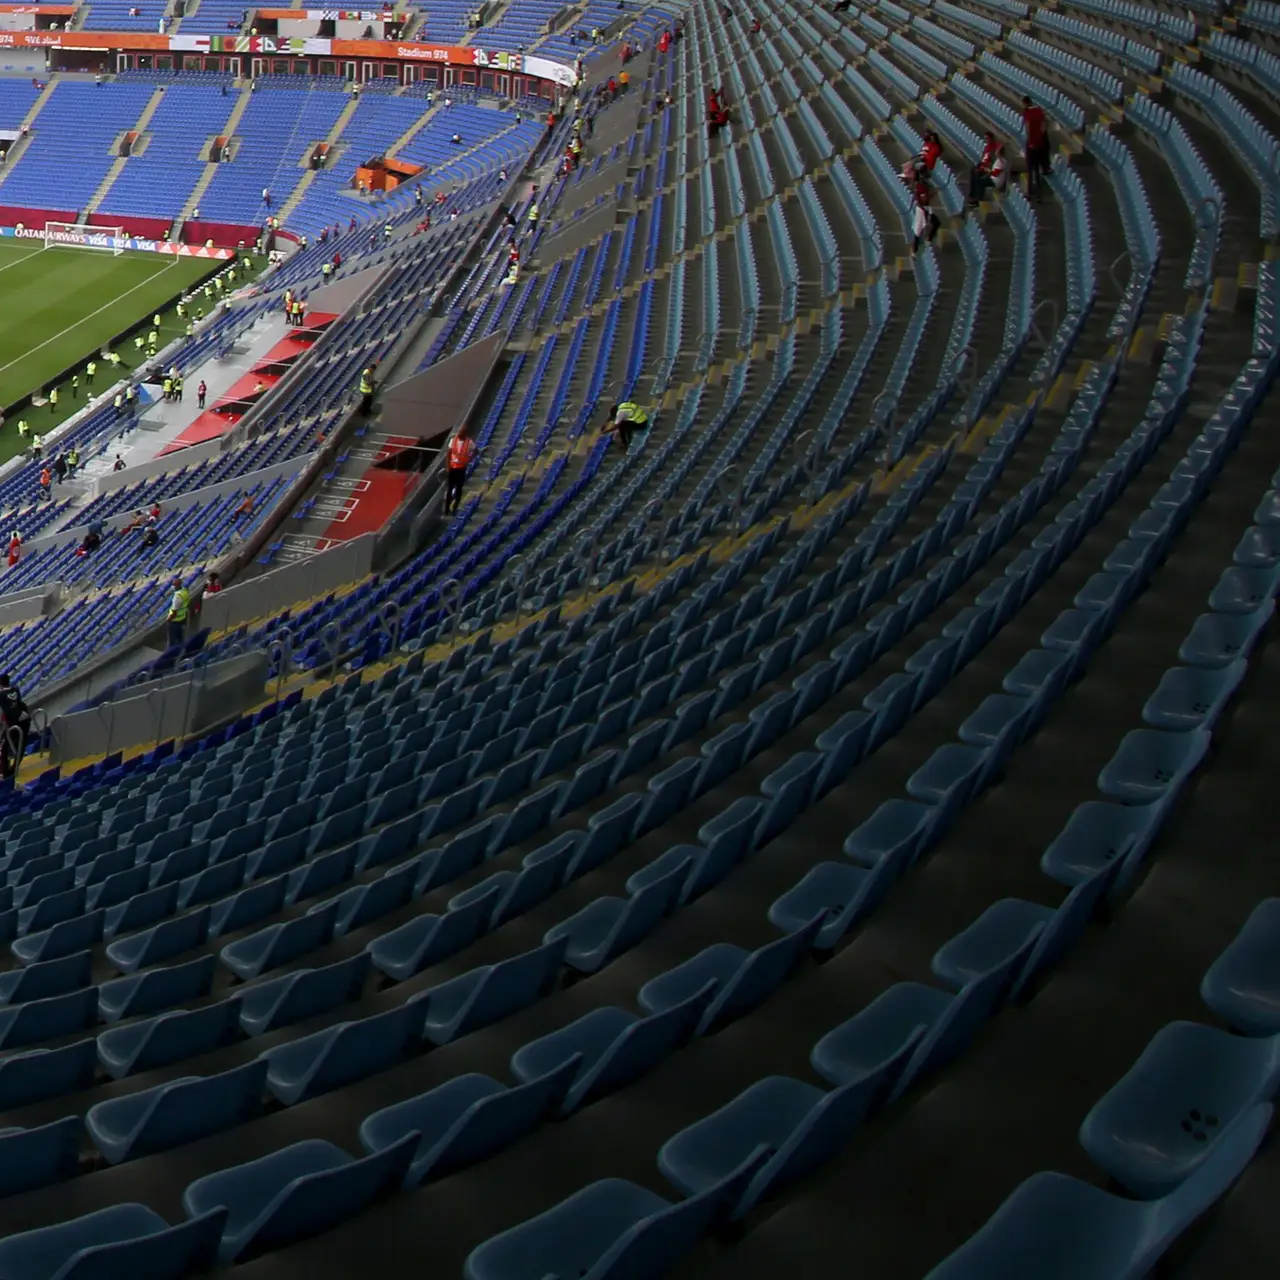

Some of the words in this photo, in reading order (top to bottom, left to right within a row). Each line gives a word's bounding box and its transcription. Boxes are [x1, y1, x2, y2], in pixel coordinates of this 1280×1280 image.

[398, 47, 432, 58] Stadium
[433, 49, 449, 60] 974
[15, 228, 45, 239] QATAR
[48, 231, 85, 243] AIRWAYS
[89, 235, 108, 246] VISA
[137, 240, 156, 251] VISA
